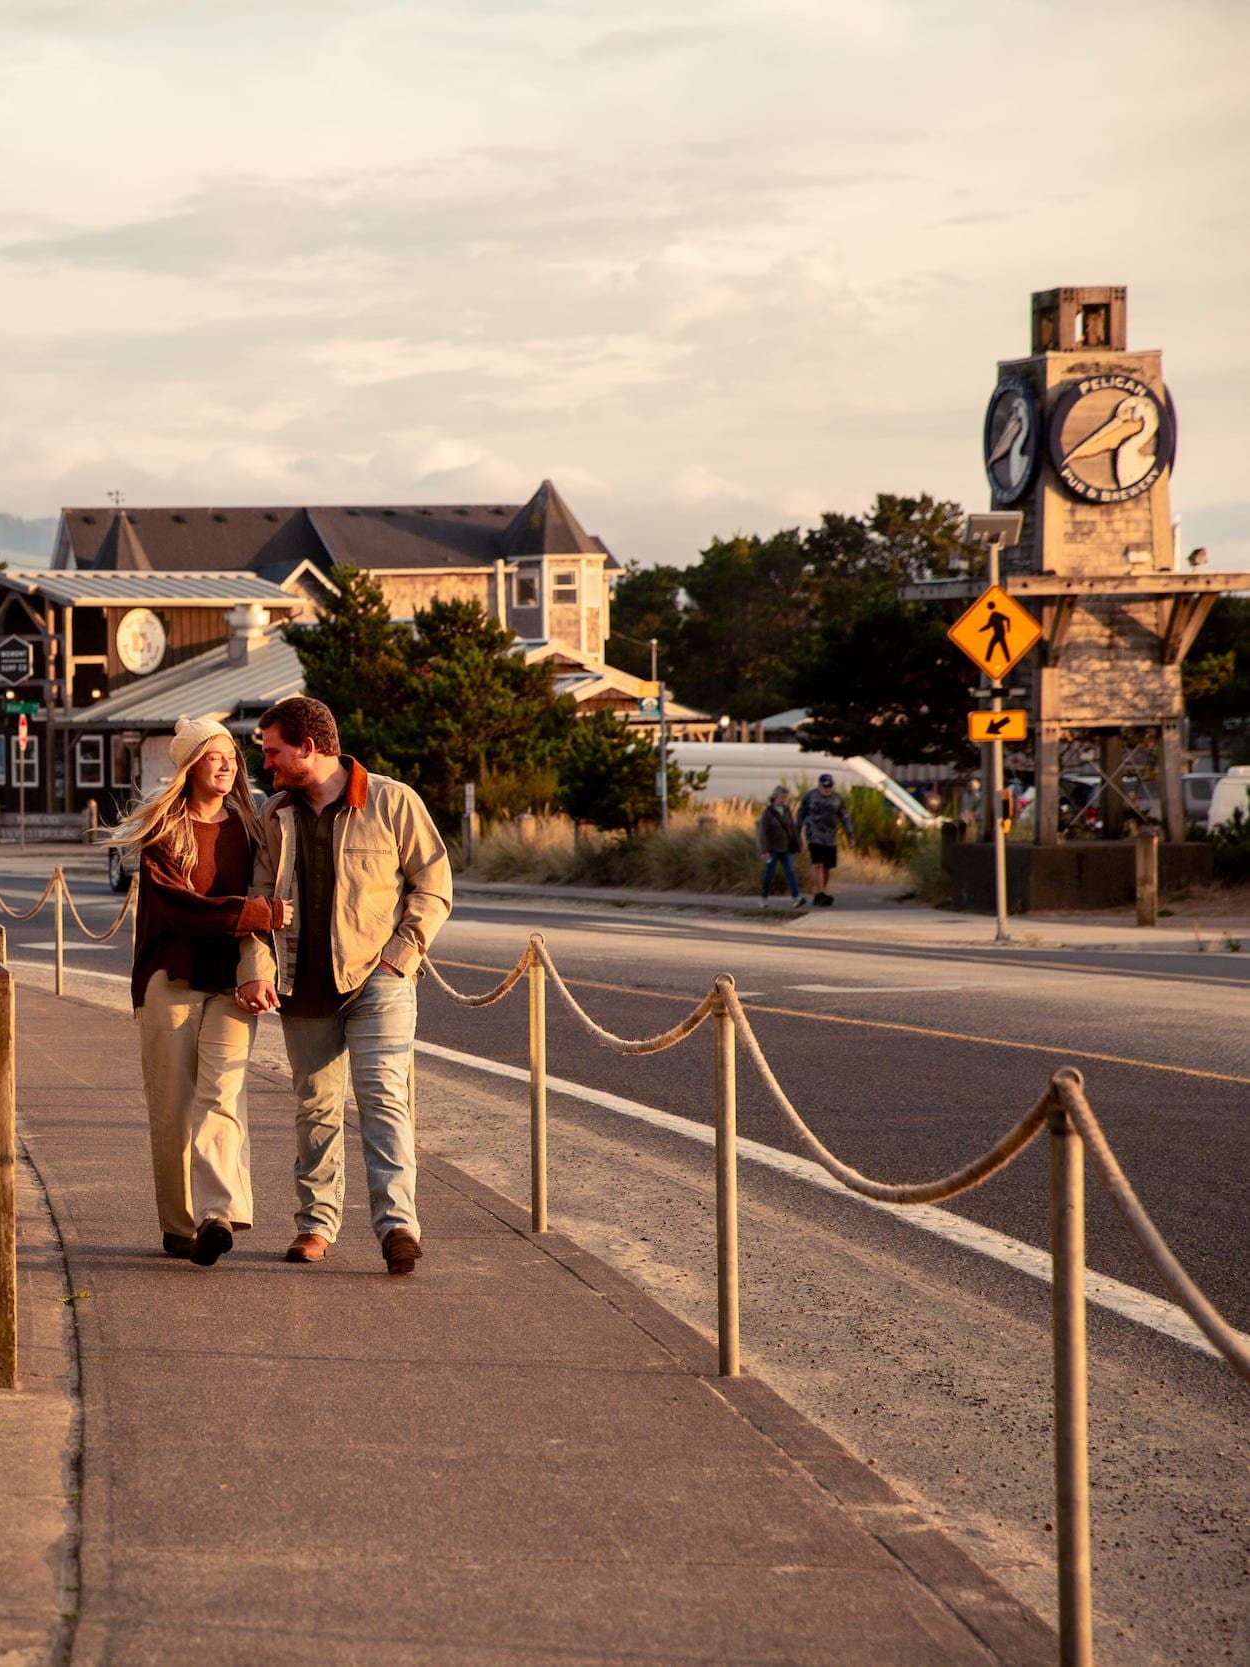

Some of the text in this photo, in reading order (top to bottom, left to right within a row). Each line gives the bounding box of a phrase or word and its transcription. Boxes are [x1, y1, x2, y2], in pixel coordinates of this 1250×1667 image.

[1078, 376, 1147, 397] PELICAN
[1061, 467, 1085, 493] PUB
[1101, 469, 1160, 502] BREWERY
